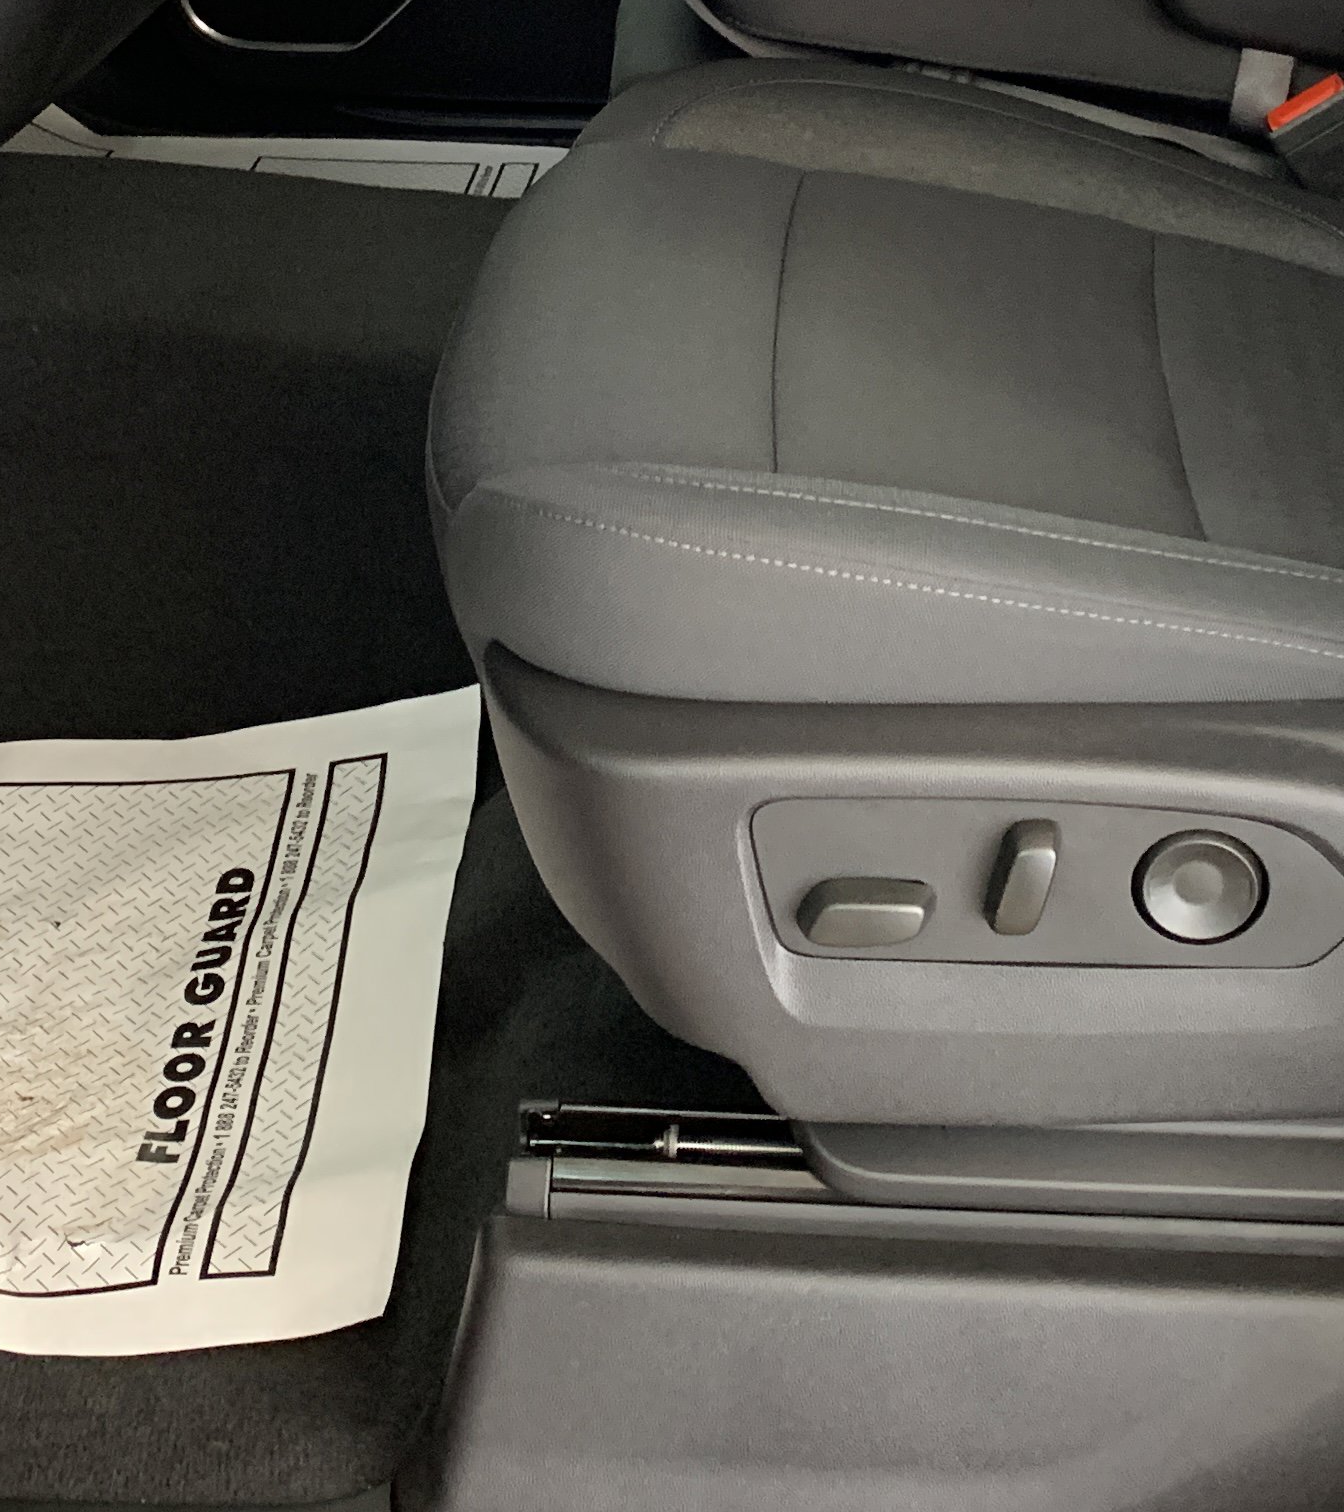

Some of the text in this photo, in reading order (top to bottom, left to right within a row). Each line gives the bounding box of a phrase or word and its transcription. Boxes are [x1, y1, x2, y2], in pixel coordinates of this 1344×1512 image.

[296, 773, 318, 808] Reorder
[256, 924, 278, 958] Carpet
[246, 960, 270, 1006] Premium
[135, 867, 255, 1164] FLOOR GUARD
[234, 1015, 258, 1055] Reorder
[233, 1055, 250, 1066] to
[220, 1065, 247, 1110] 247-5432
[195, 1146, 226, 1198] Protection
[169, 1217, 199, 1276] Premium
